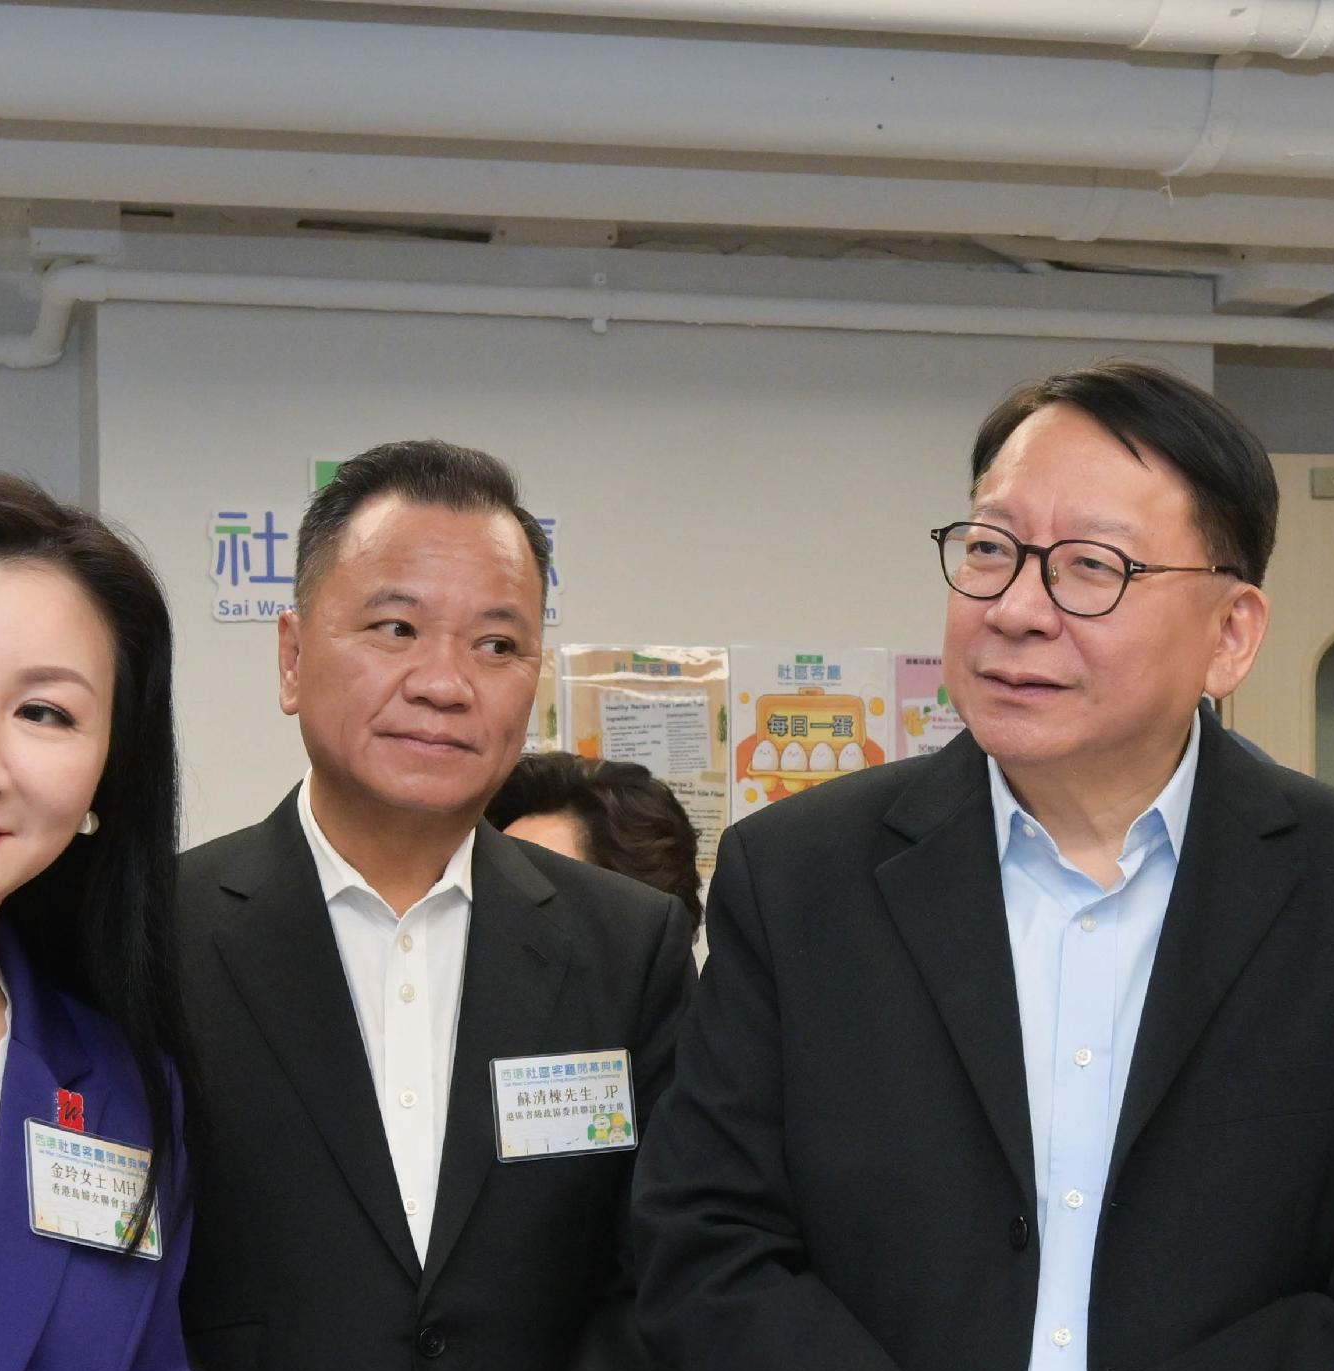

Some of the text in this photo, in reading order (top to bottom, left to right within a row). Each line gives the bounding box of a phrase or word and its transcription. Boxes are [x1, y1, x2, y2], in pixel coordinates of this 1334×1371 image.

[219, 600, 249, 616] Sai
[768, 714, 854, 737] 每日一蛋
[604, 1085, 618, 1099] JP
[51, 1162, 107, 1189] 金玲女士
[113, 1178, 136, 1197] MH
